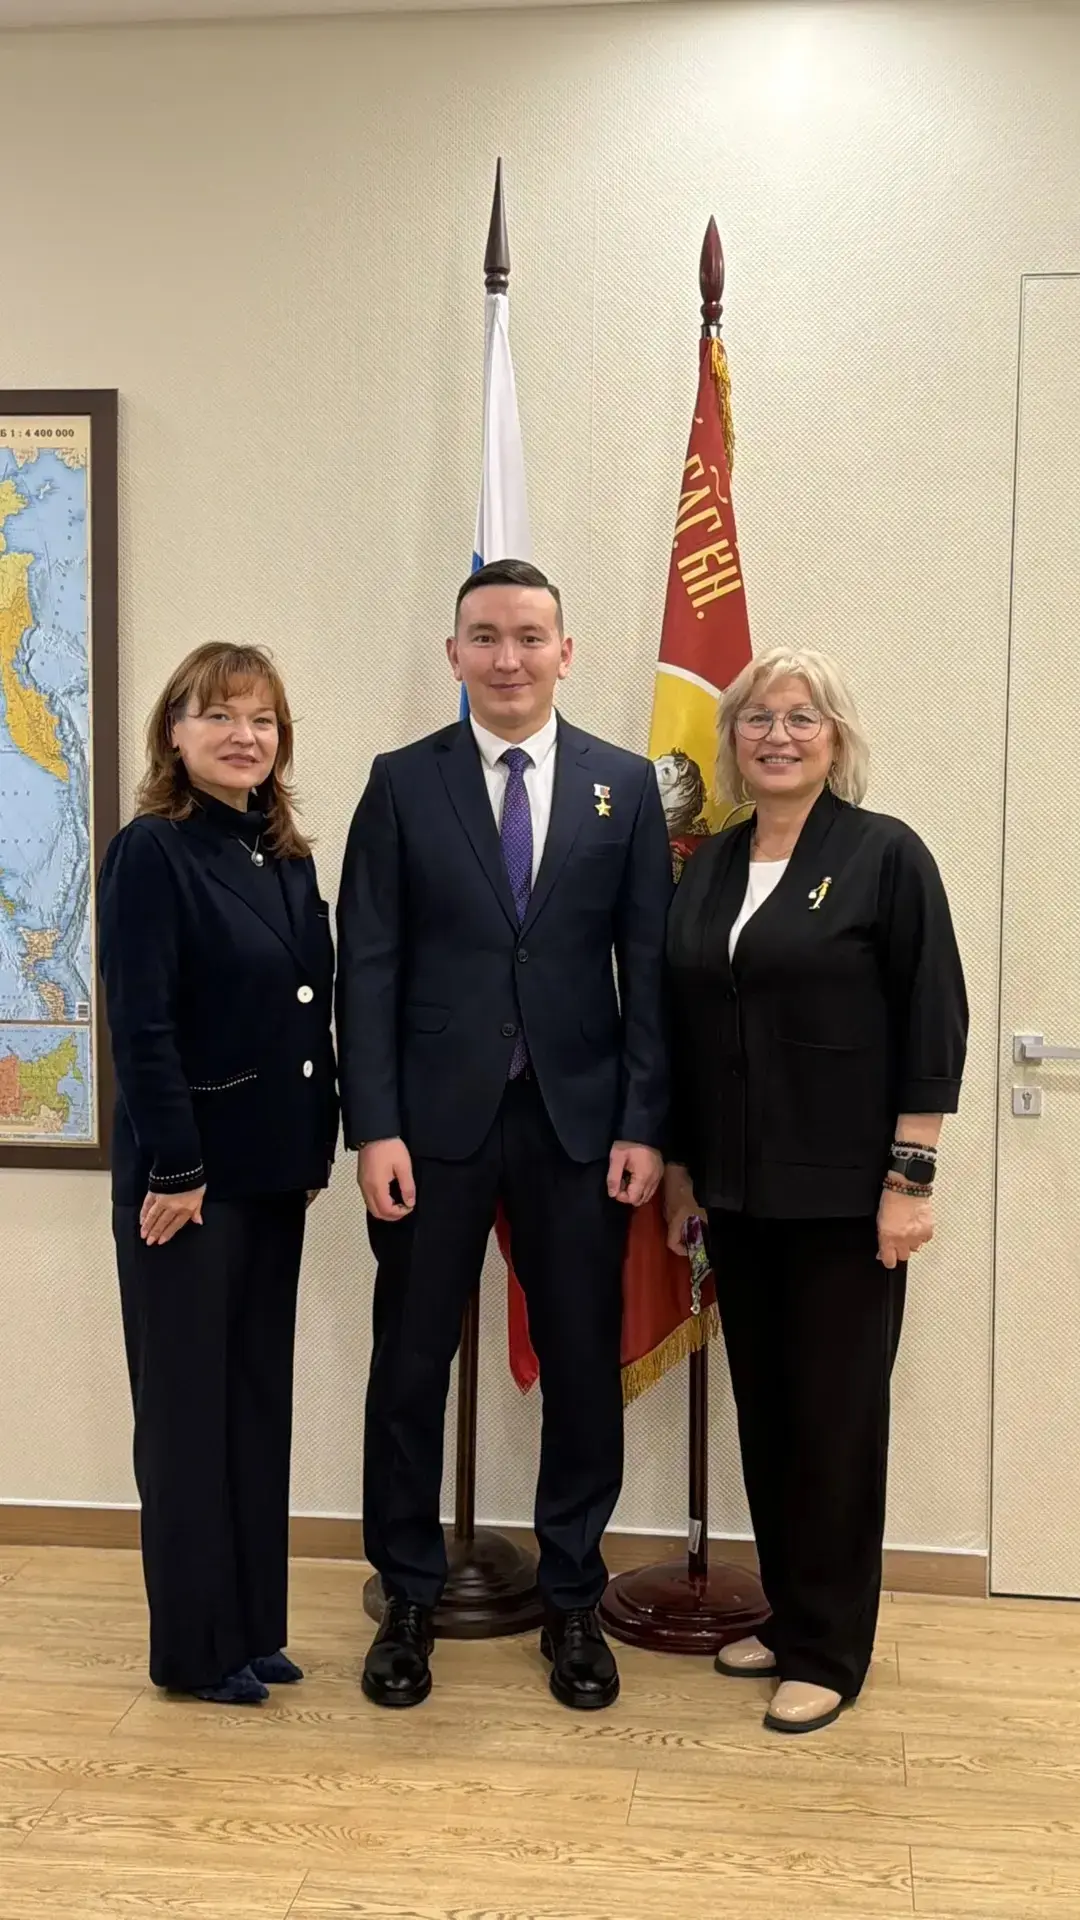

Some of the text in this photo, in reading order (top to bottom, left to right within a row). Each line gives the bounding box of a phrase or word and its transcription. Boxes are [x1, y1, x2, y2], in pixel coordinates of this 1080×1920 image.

[25, 428, 31, 437] 4
[34, 428, 53, 437] 400
[55, 428, 75, 437] 000
